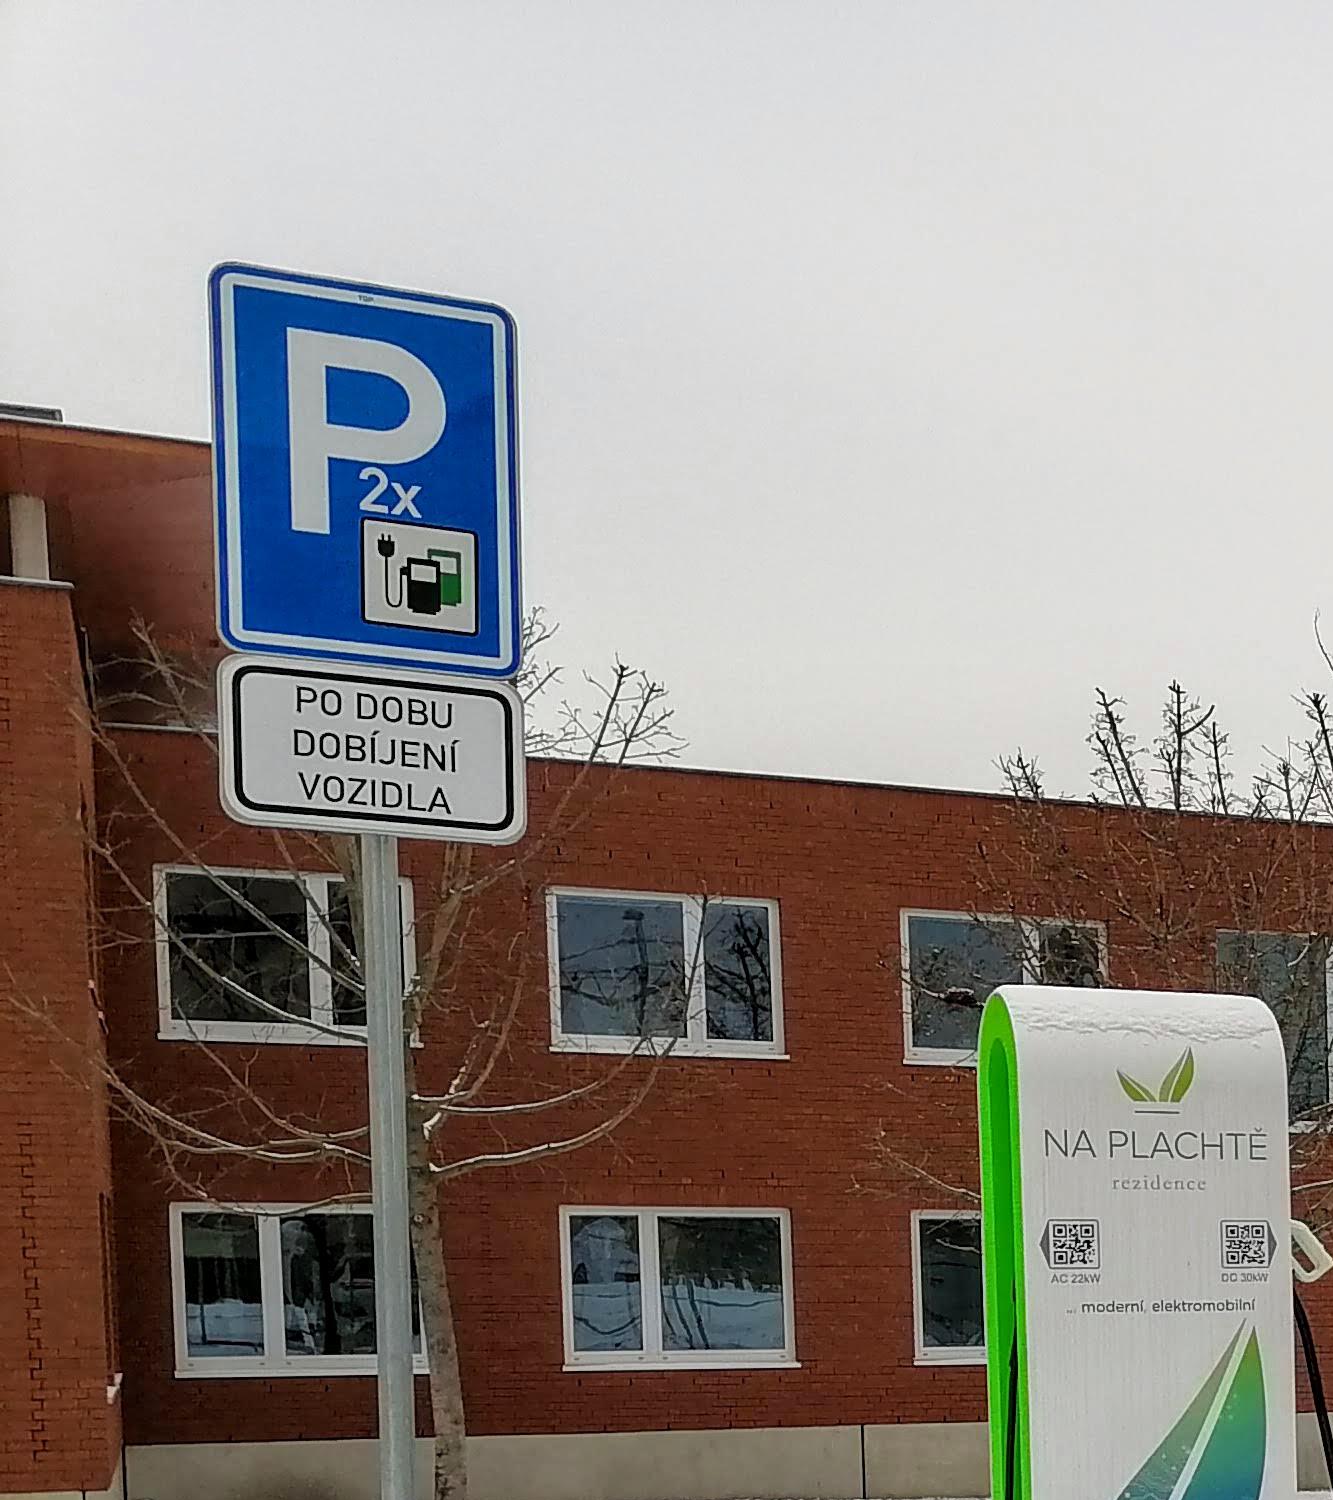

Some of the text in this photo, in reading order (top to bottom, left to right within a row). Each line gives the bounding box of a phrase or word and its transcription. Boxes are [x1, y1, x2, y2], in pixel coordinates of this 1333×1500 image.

[286, 326, 447, 534] P
[358, 466, 422, 519] 2x
[296, 685, 452, 728] PO DOBU
[293, 729, 461, 772] DOBÍJENÍ
[298, 771, 451, 814] VOZIDLA
[1044, 1127, 1268, 1160] NA PLACHTĚ
[1112, 1174, 1206, 1191] rezidence
[1050, 1273, 1101, 1284] AC 22kW
[1152, 1298, 1256, 1312] elektromobilní
